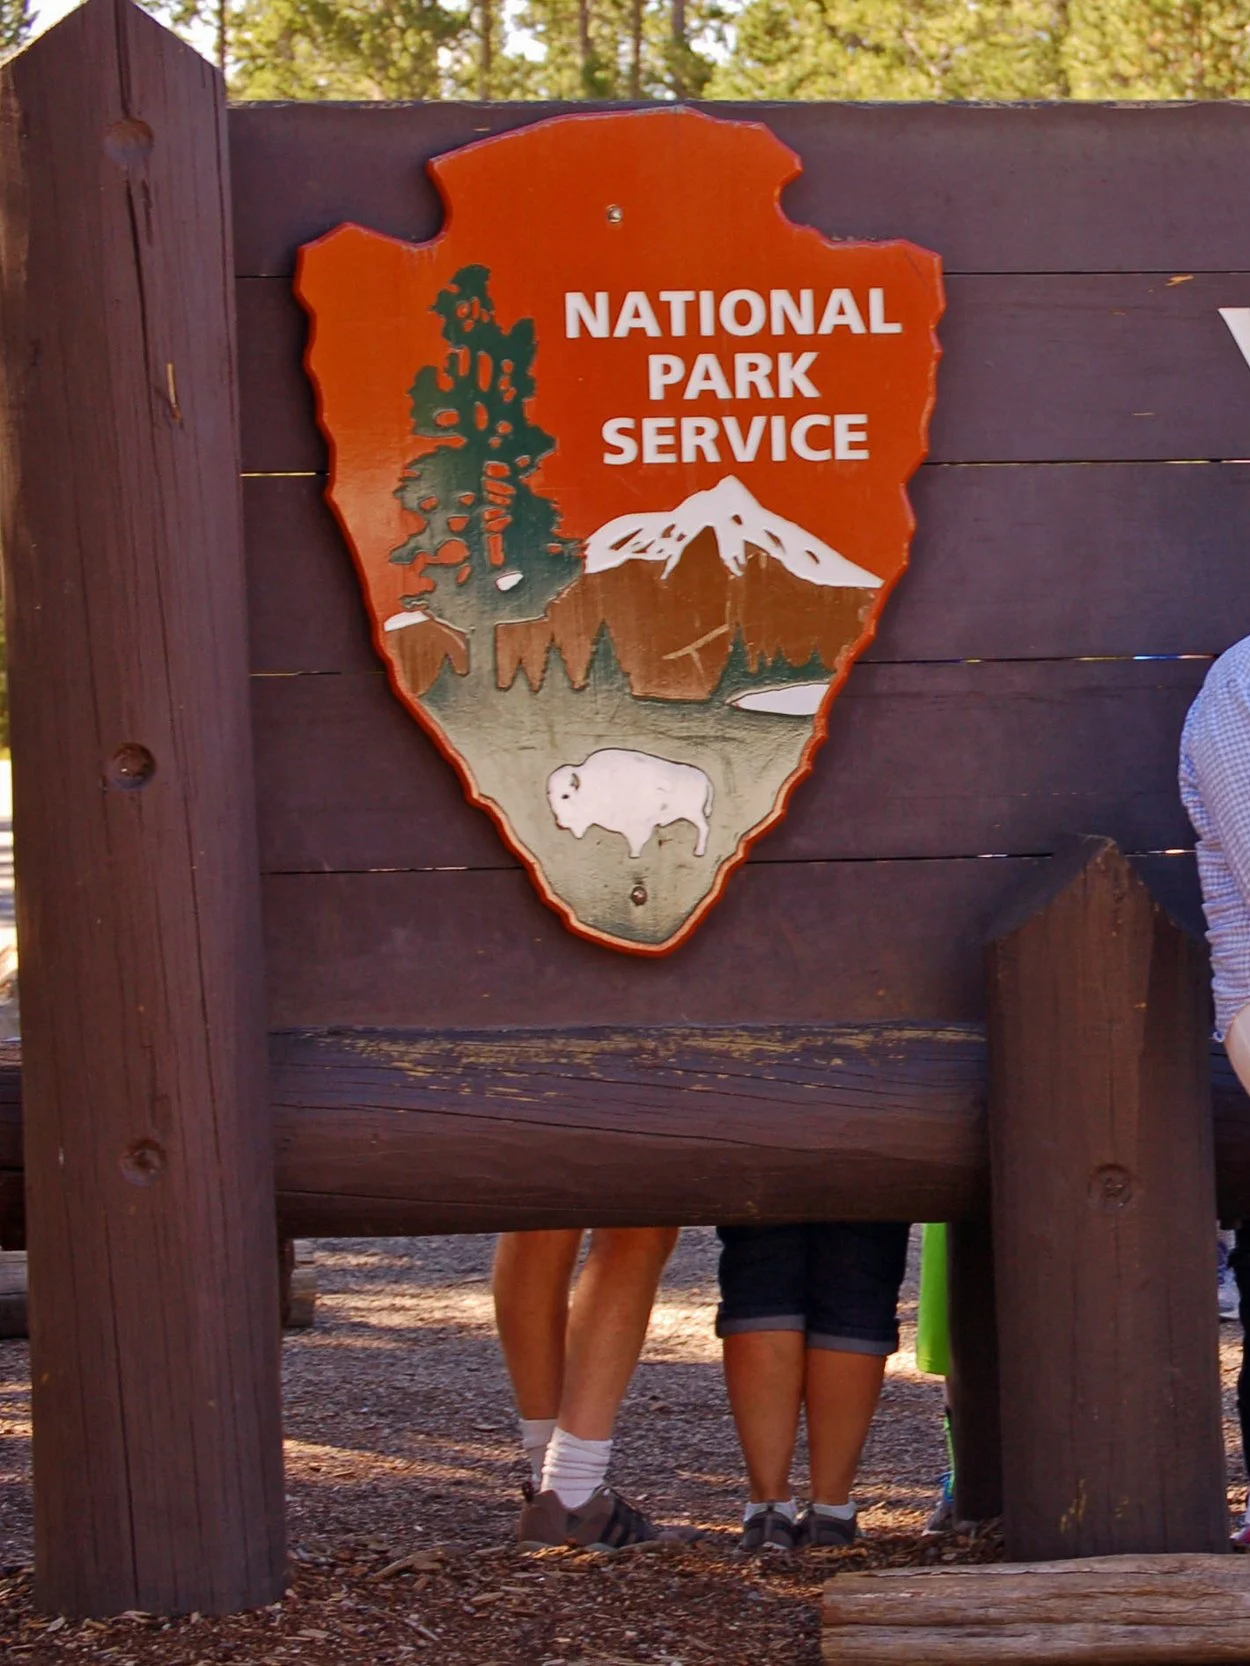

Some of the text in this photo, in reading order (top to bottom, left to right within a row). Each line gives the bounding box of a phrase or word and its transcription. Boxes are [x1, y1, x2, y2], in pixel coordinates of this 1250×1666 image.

[565, 288, 903, 339] NATIONAL
[649, 352, 820, 400] PARK
[602, 414, 870, 465] SERVICE
